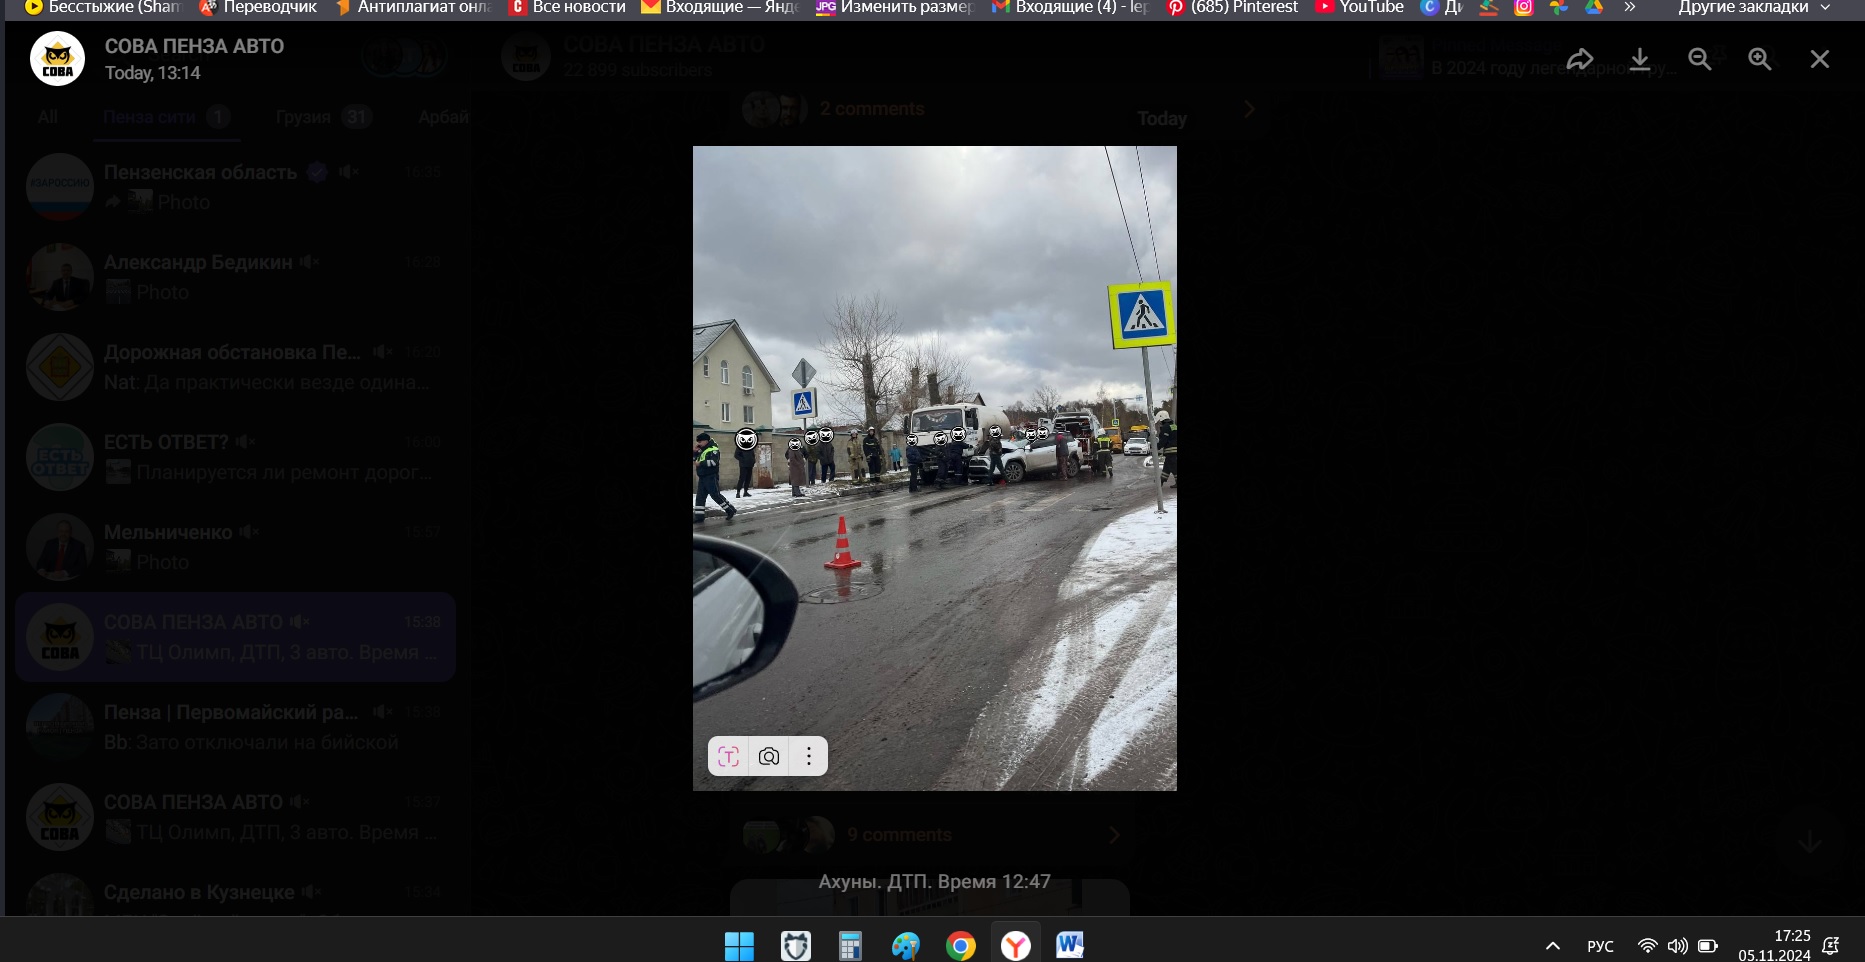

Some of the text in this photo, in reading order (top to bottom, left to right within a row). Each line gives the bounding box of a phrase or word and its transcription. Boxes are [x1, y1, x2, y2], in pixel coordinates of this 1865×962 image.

[50, 0, 134, 12] Бесстыжие
[225, 0, 317, 15] Переводчик
[358, 0, 456, 12] Антиплагиат
[534, 0, 625, 12] Все новости
[667, 0, 743, 14] Входящие
[816, 2, 836, 11] JPG
[842, 0, 917, 12] Изменить
[1017, 0, 1093, 14] Входящие
[1098, 0, 1116, 14] (4)
[1192, 0, 1298, 14] (685) Pinterest
[1340, 0, 1404, 12] YouTube
[1679, 0, 1808, 15] Другие закладки
[105, 38, 284, 54] СОВА ПЕНЗА АВТО
[564, 35, 765, 53] СОВА ПЕНЗА АВТО
[43, 67, 73, 76] СОВА
[105, 65, 201, 83] Today, 13:14
[513, 64, 540, 72] СОВА
[564, 62, 712, 79] 22 899 subscribers
[1432, 61, 1442, 74] В
[1447, 61, 1486, 75] 2024
[1491, 64, 1525, 79] году
[820, 101, 925, 116] 2 comments
[38, 109, 57, 123] All
[104, 110, 195, 124] Пенза сити
[214, 110, 221, 123] 1
[277, 110, 330, 127] Грузия
[348, 110, 364, 124] 31
[1137, 110, 1187, 129] Today
[105, 163, 297, 180] Пензенская область
[405, 166, 440, 177] 16:35
[159, 194, 210, 209] Photo
[104, 254, 292, 273] Александр Бедикин
[405, 256, 440, 268] 16:28
[138, 284, 189, 300] Photo
[104, 344, 201, 363] Дорожная
[208, 344, 316, 360] обстановка
[406, 346, 440, 358] 16:20
[105, 374, 139, 390] Nat:
[144, 374, 169, 393] Да
[176, 378, 294, 393] практически
[301, 378, 354, 392] везде
[105, 434, 228, 450] ЕСТЬ ОТВЕТ?
[405, 436, 440, 448] 16:00
[39, 449, 82, 462] ЕСТЬ
[32, 463, 88, 475] ОТВЕТ
[138, 464, 256, 484] Планируется
[263, 468, 284, 479] ли
[291, 468, 359, 483] ремонт
[105, 524, 232, 540] Мельниченко
[405, 526, 440, 537] 15:57
[138, 554, 189, 569] Photo
[104, 614, 283, 630] СОВА ПЕНЗА АВТО
[405, 616, 440, 628] 15:38
[42, 648, 79, 659] СОВА
[136, 644, 163, 663] ТЦ
[169, 644, 234, 664] Олимп,
[240, 644, 284, 663] ДТП,
[290, 644, 300, 661] 3
[307, 648, 353, 660] авто.
[360, 644, 418, 663] Время
[105, 704, 161, 720] Пенза
[177, 704, 316, 723] Первомайский
[405, 704, 440, 720] 15:38
[105, 733, 398, 750] Bb: Зато отключали на бийской
[104, 794, 283, 810] СОВА ПЕНЗА АВТО
[406, 796, 440, 808] 15:37
[41, 828, 79, 840] СОВА
[136, 824, 163, 843] ТЦ
[169, 824, 234, 842] Олимп,
[240, 824, 284, 843] ДТП,
[291, 824, 300, 839] 3
[307, 828, 353, 839] авто.
[360, 825, 418, 843] Время
[848, 827, 952, 841] 9 comments
[819, 874, 1051, 892] Ахуны. ДТП. Время 12:47
[104, 884, 295, 903] Сделано в Кузнецке
[405, 886, 440, 897] 15:34
[1776, 930, 1811, 941] 17:25
[1588, 941, 1613, 952] РУС
[1739, 950, 1811, 961] 05.11.2024
